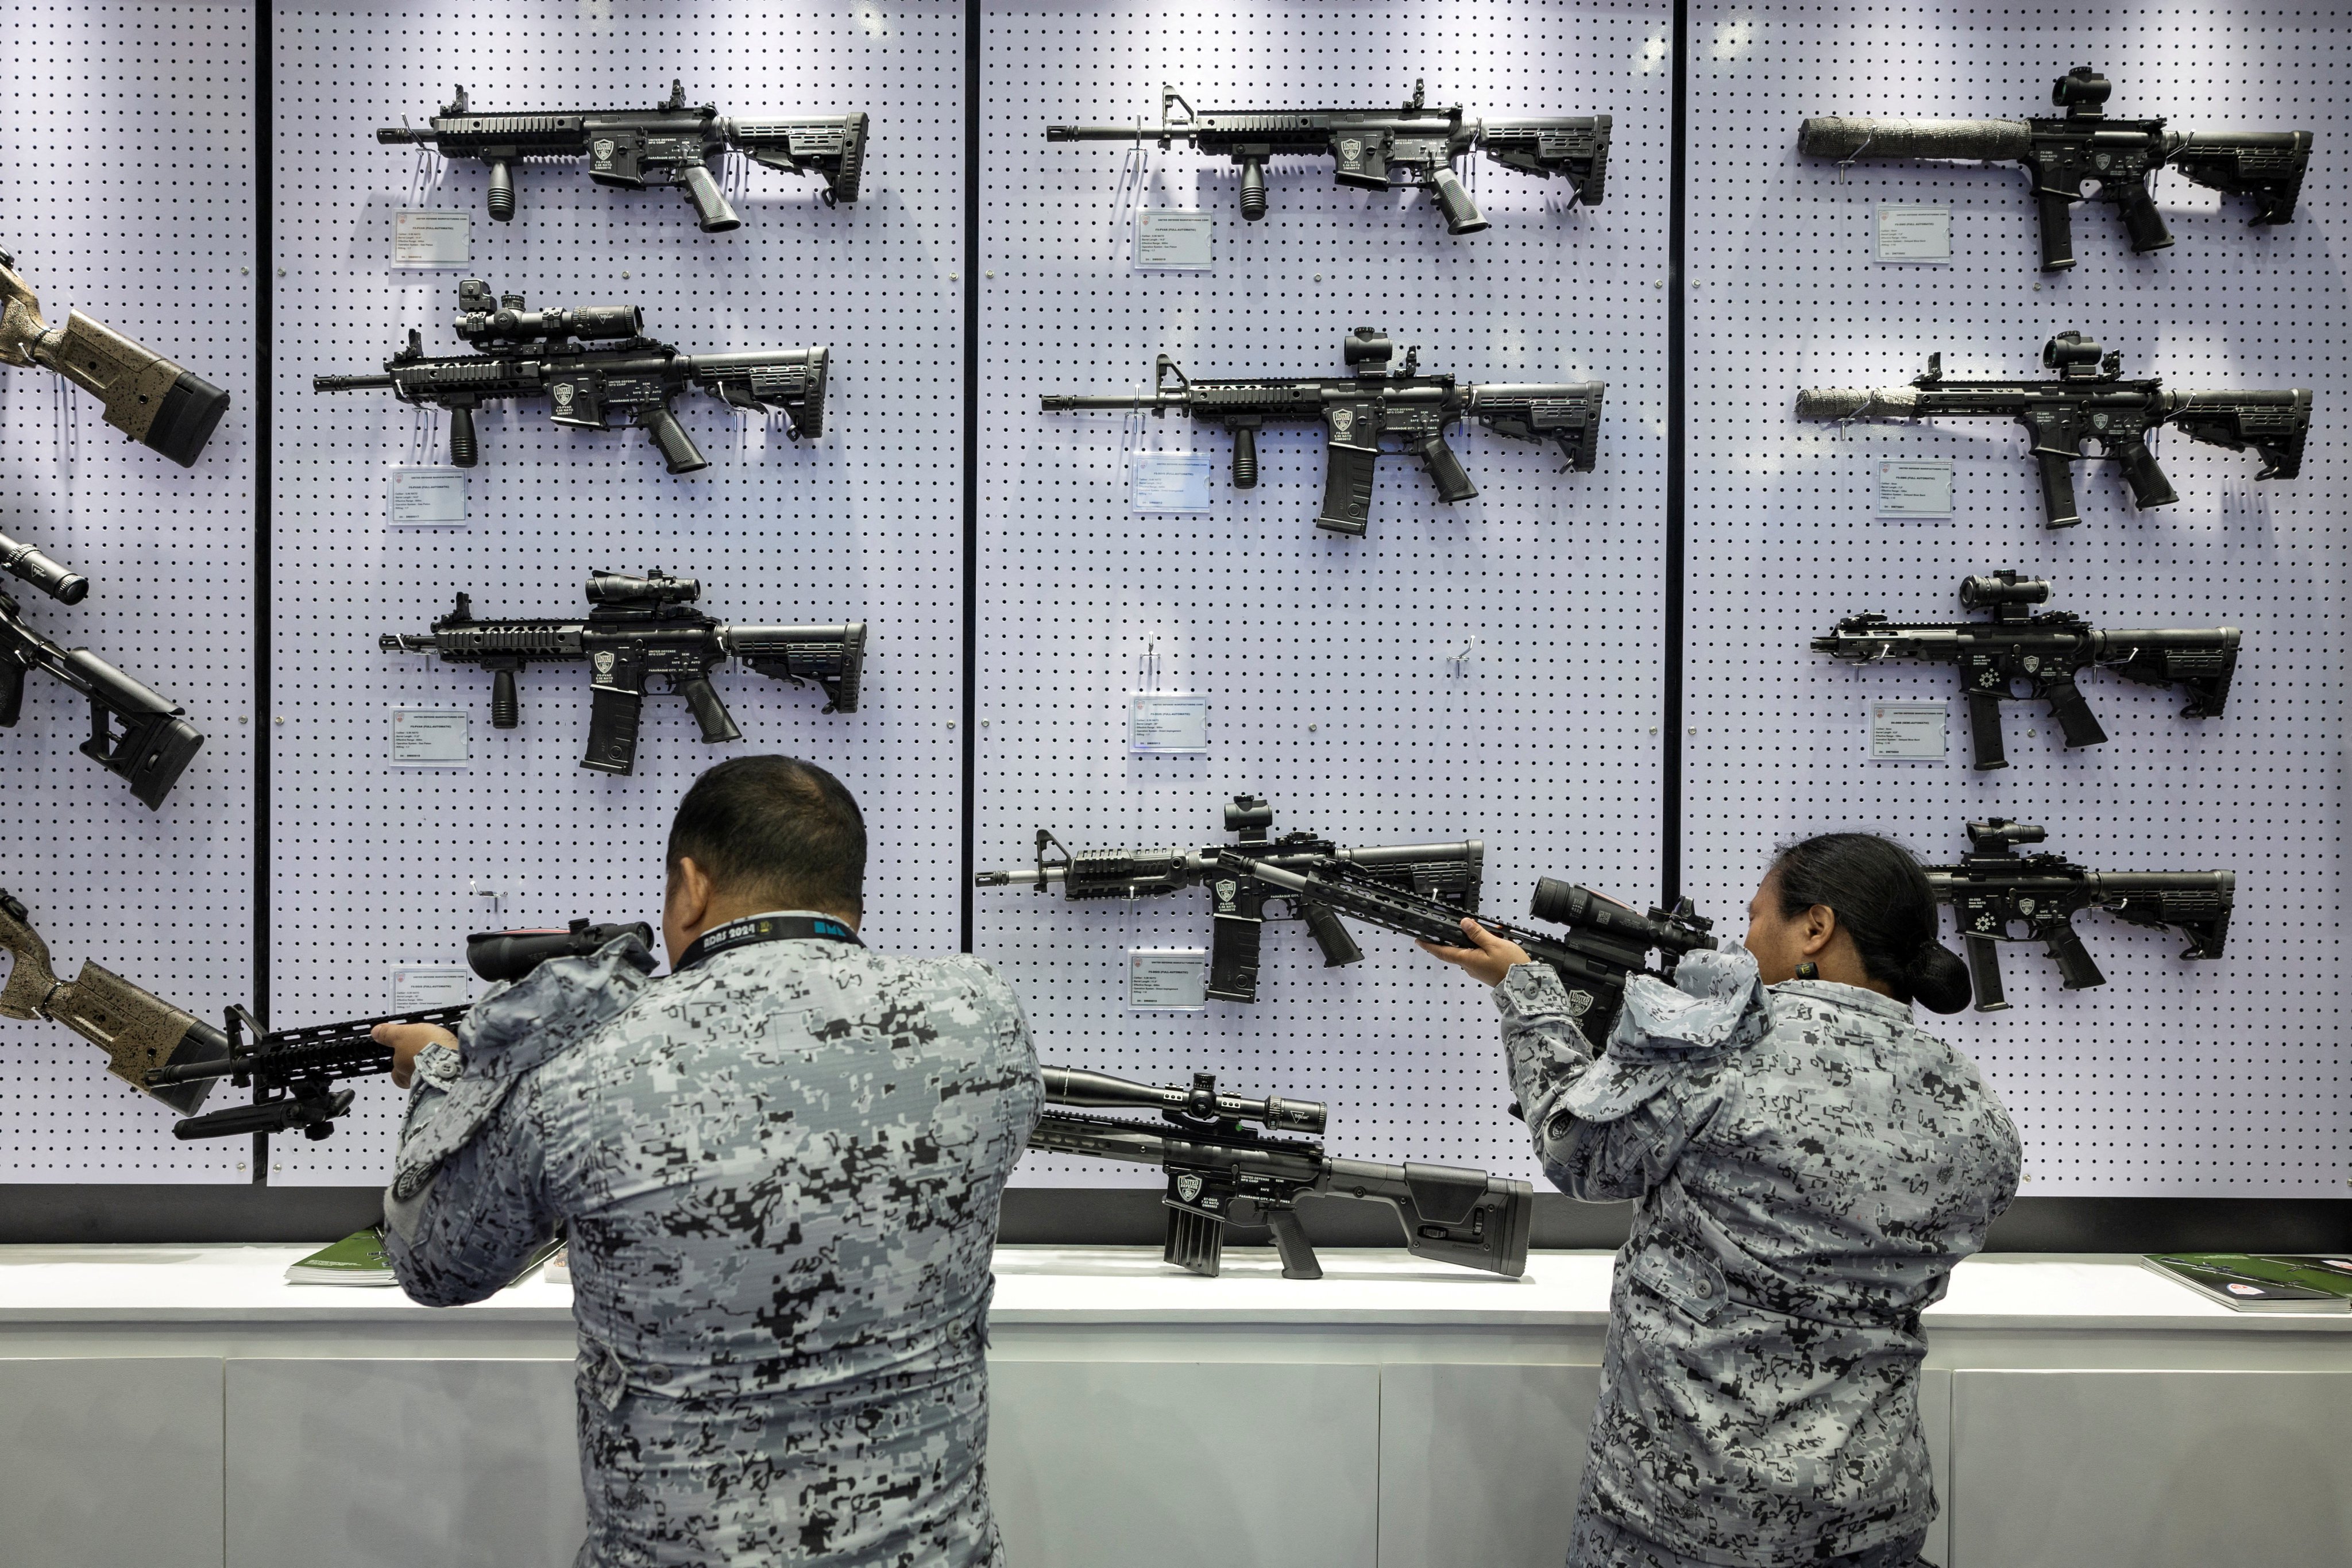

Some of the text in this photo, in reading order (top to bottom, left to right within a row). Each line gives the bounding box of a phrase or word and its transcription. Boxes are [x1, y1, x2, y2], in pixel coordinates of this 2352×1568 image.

[704, 930, 726, 947] ADAS
[729, 924, 755, 938] 2024
[1573, 992, 1590, 1002] UNITED
